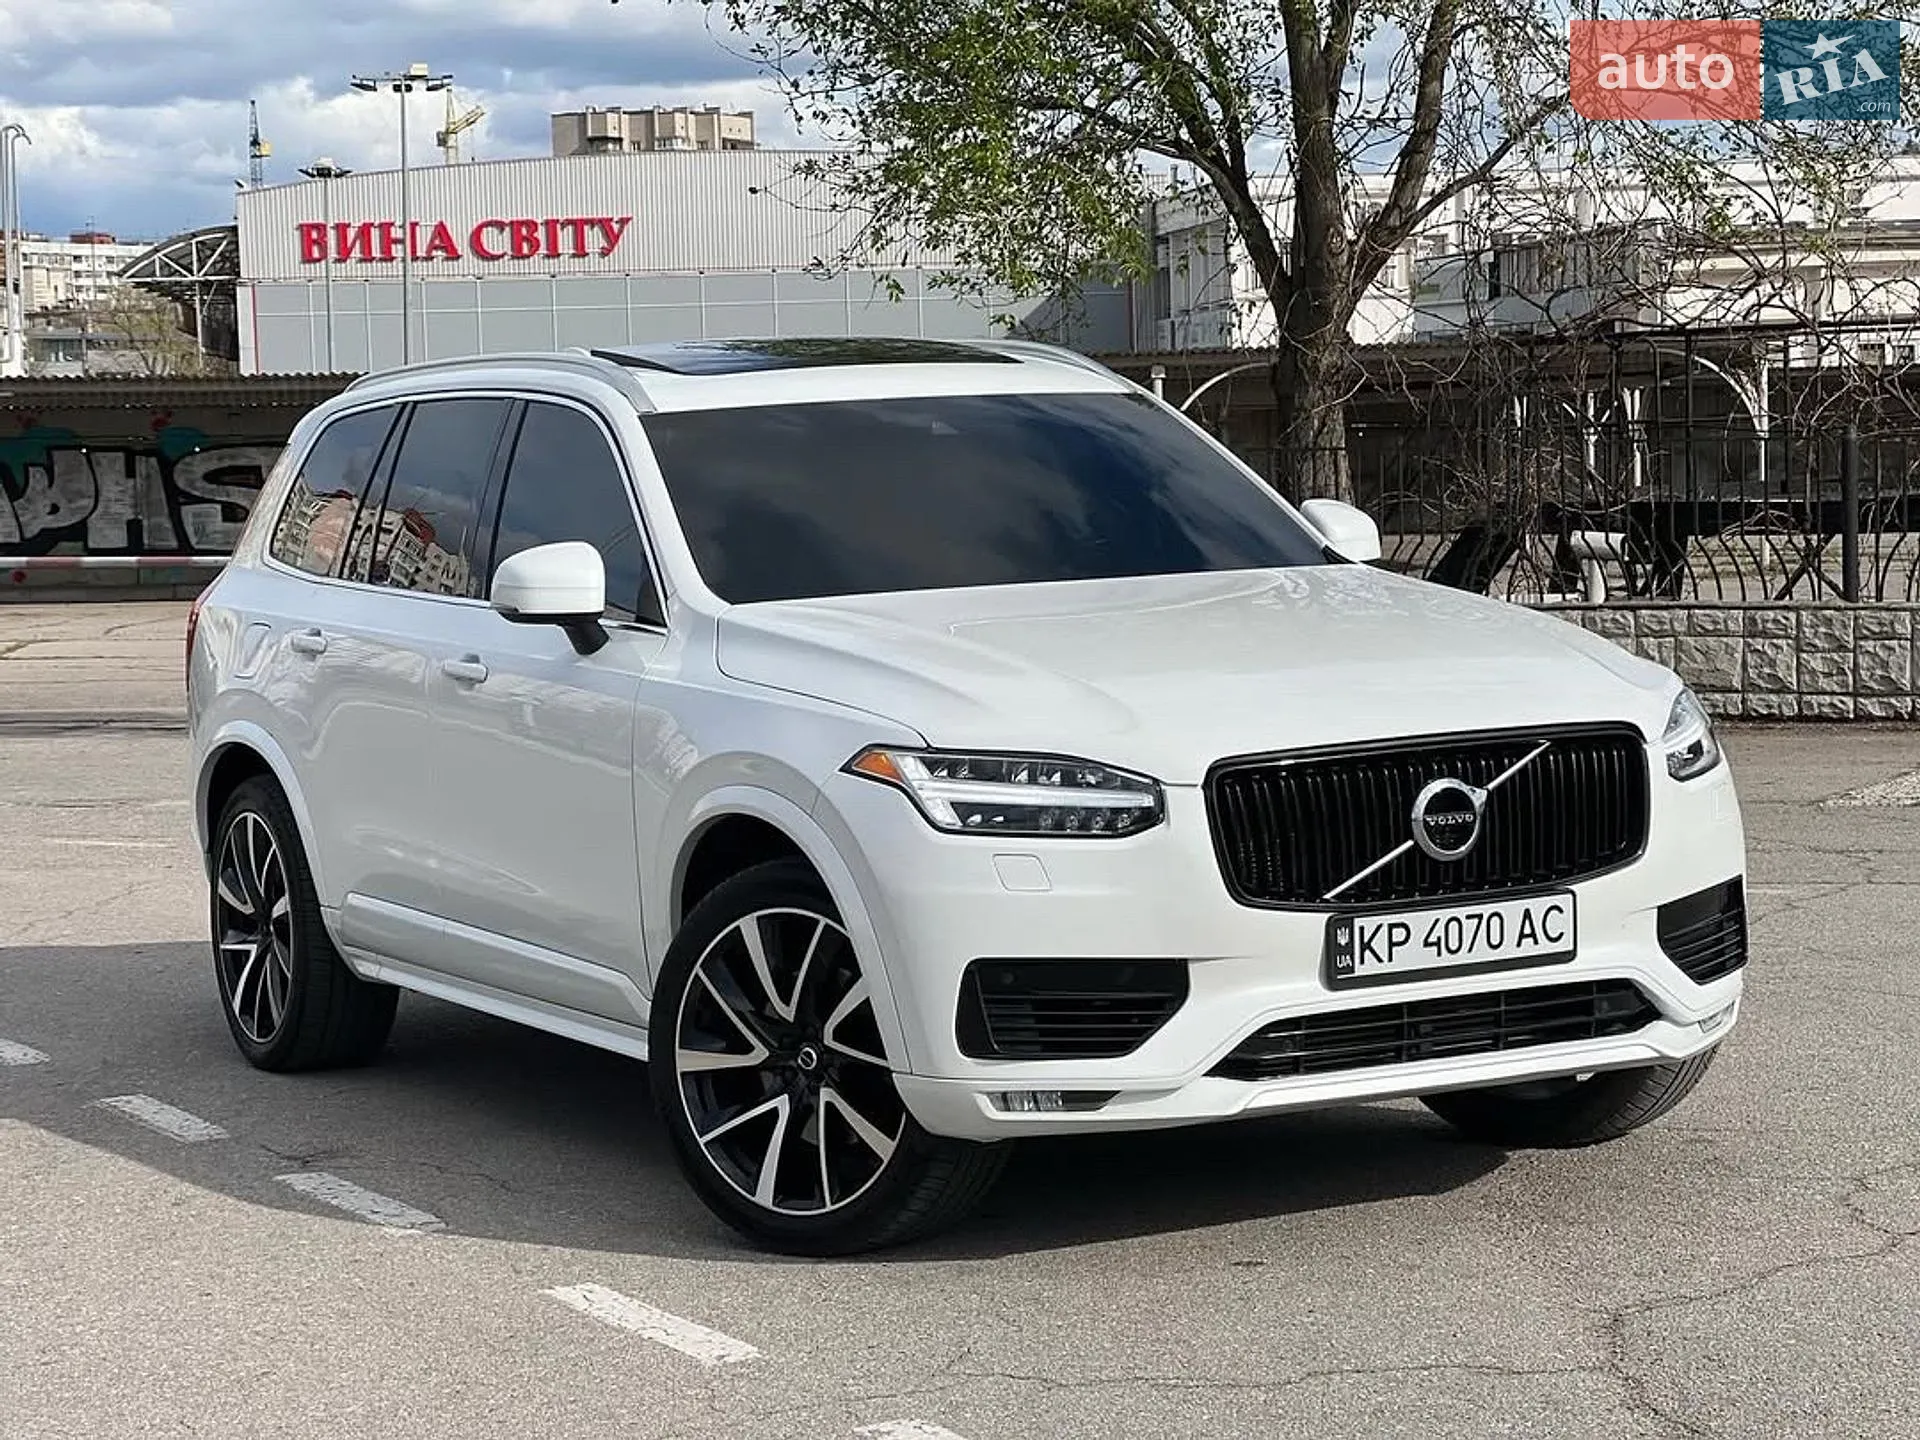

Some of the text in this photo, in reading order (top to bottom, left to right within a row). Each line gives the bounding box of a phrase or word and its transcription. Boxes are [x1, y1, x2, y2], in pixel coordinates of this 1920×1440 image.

[296, 215, 633, 264] ВИНА СВІТУ
[1424, 812, 1474, 826] VOLVO
[1358, 904, 1564, 965] KP 4070 AC
[1337, 955, 1352, 968] UA
